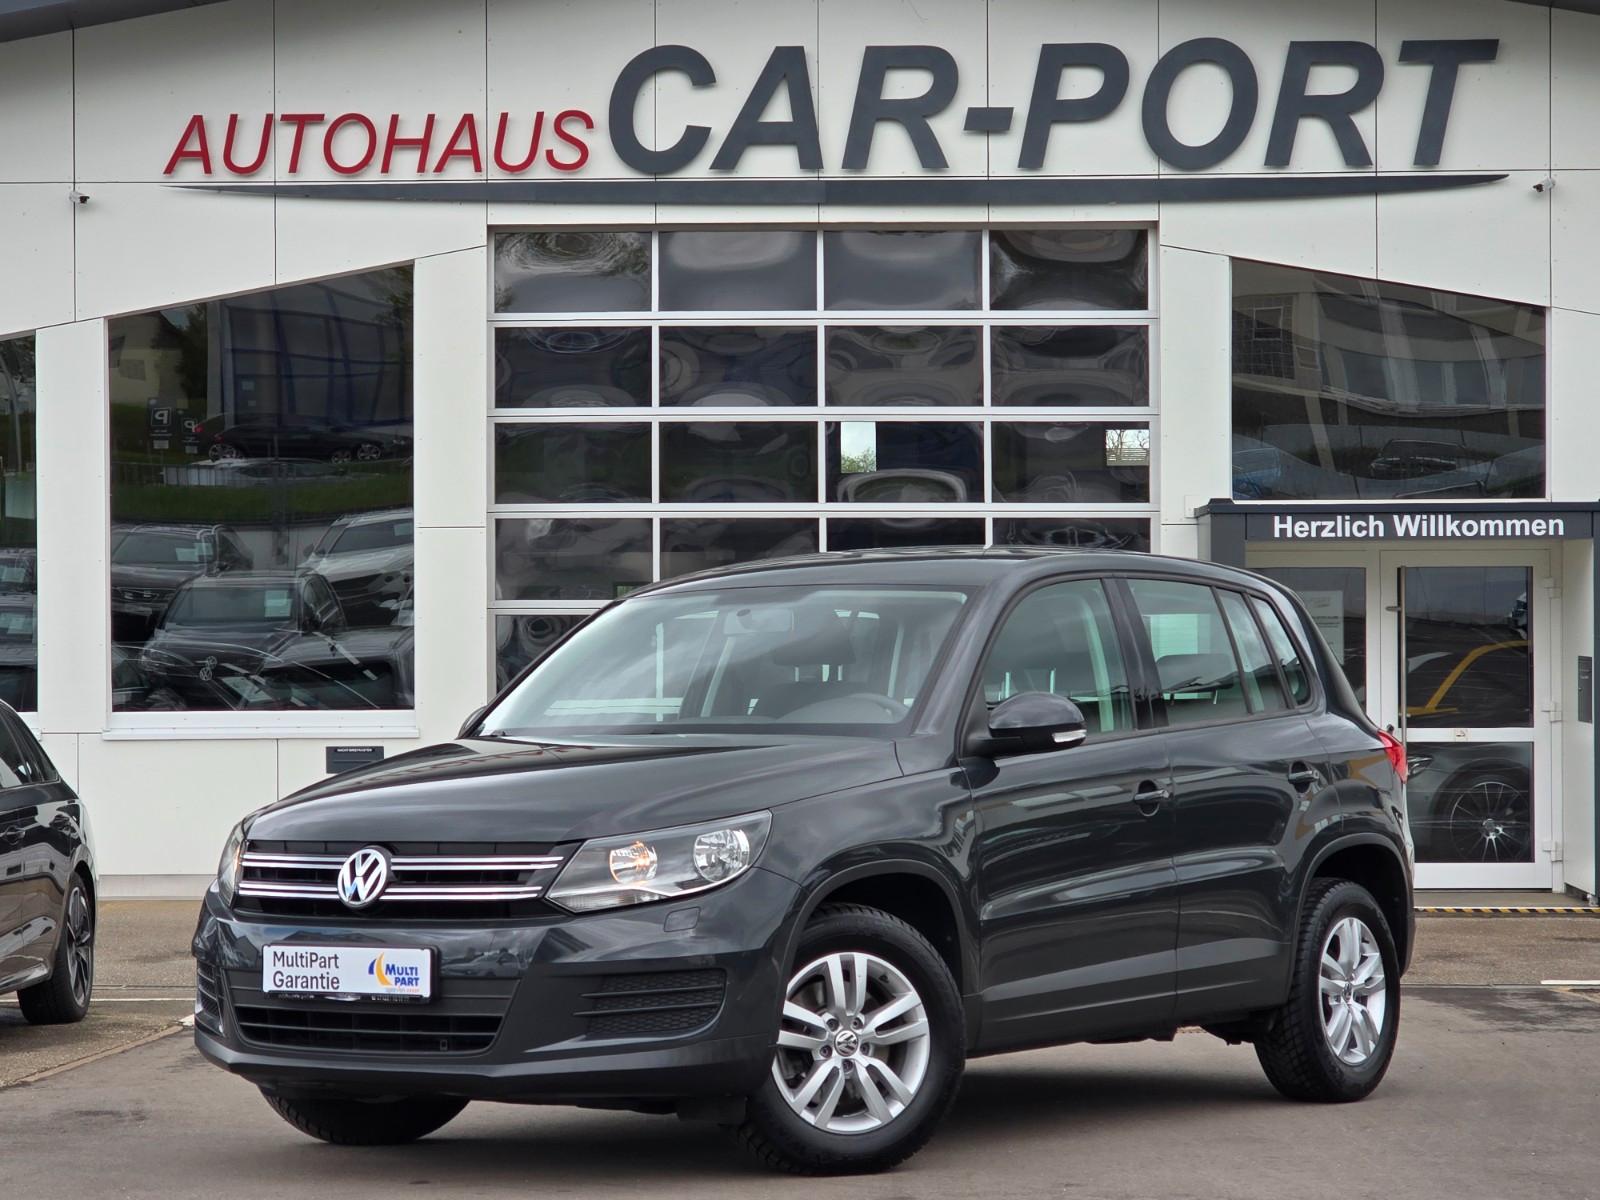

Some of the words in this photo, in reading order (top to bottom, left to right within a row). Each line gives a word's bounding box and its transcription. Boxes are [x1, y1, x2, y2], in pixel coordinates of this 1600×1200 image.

[163, 109, 595, 175] AUTOHAUS
[608, 37, 1500, 175] CAR-PORT
[1273, 514, 1385, 538] Herzlich
[1392, 514, 1565, 537] Willkommen
[338, 849, 387, 905] VW
[272, 951, 340, 969] MultiPart
[385, 964, 418, 976] MULTI
[272, 971, 340, 990] Garantie
[394, 977, 420, 987] PART
